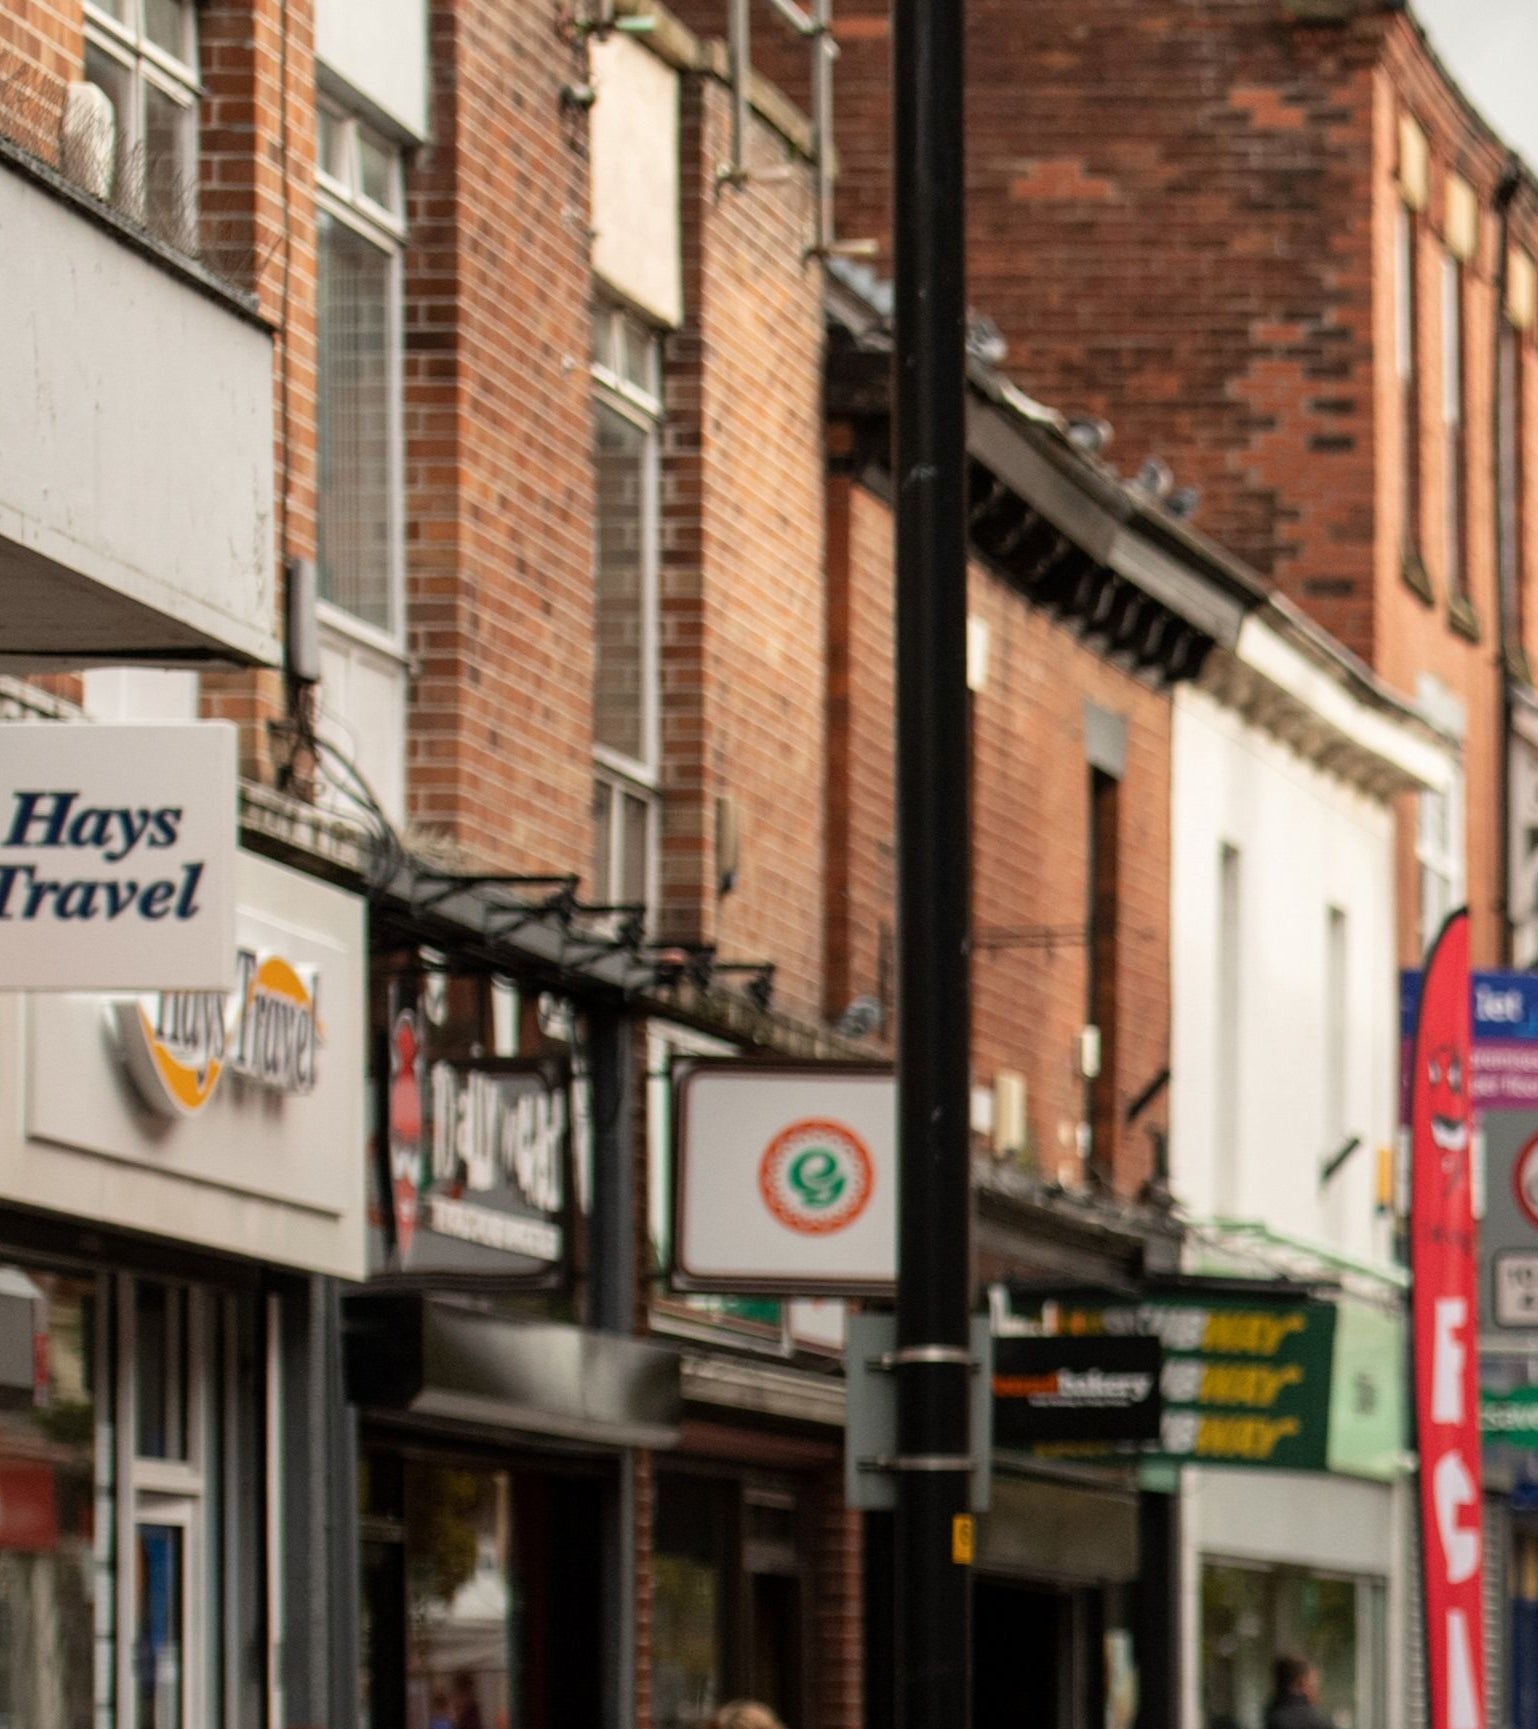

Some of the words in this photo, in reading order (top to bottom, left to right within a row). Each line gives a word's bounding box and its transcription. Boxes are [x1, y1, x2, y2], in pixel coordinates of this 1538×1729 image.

[2, 788, 184, 864] Hays
[0, 860, 205, 923] Travel
[236, 948, 320, 1092] Travel
